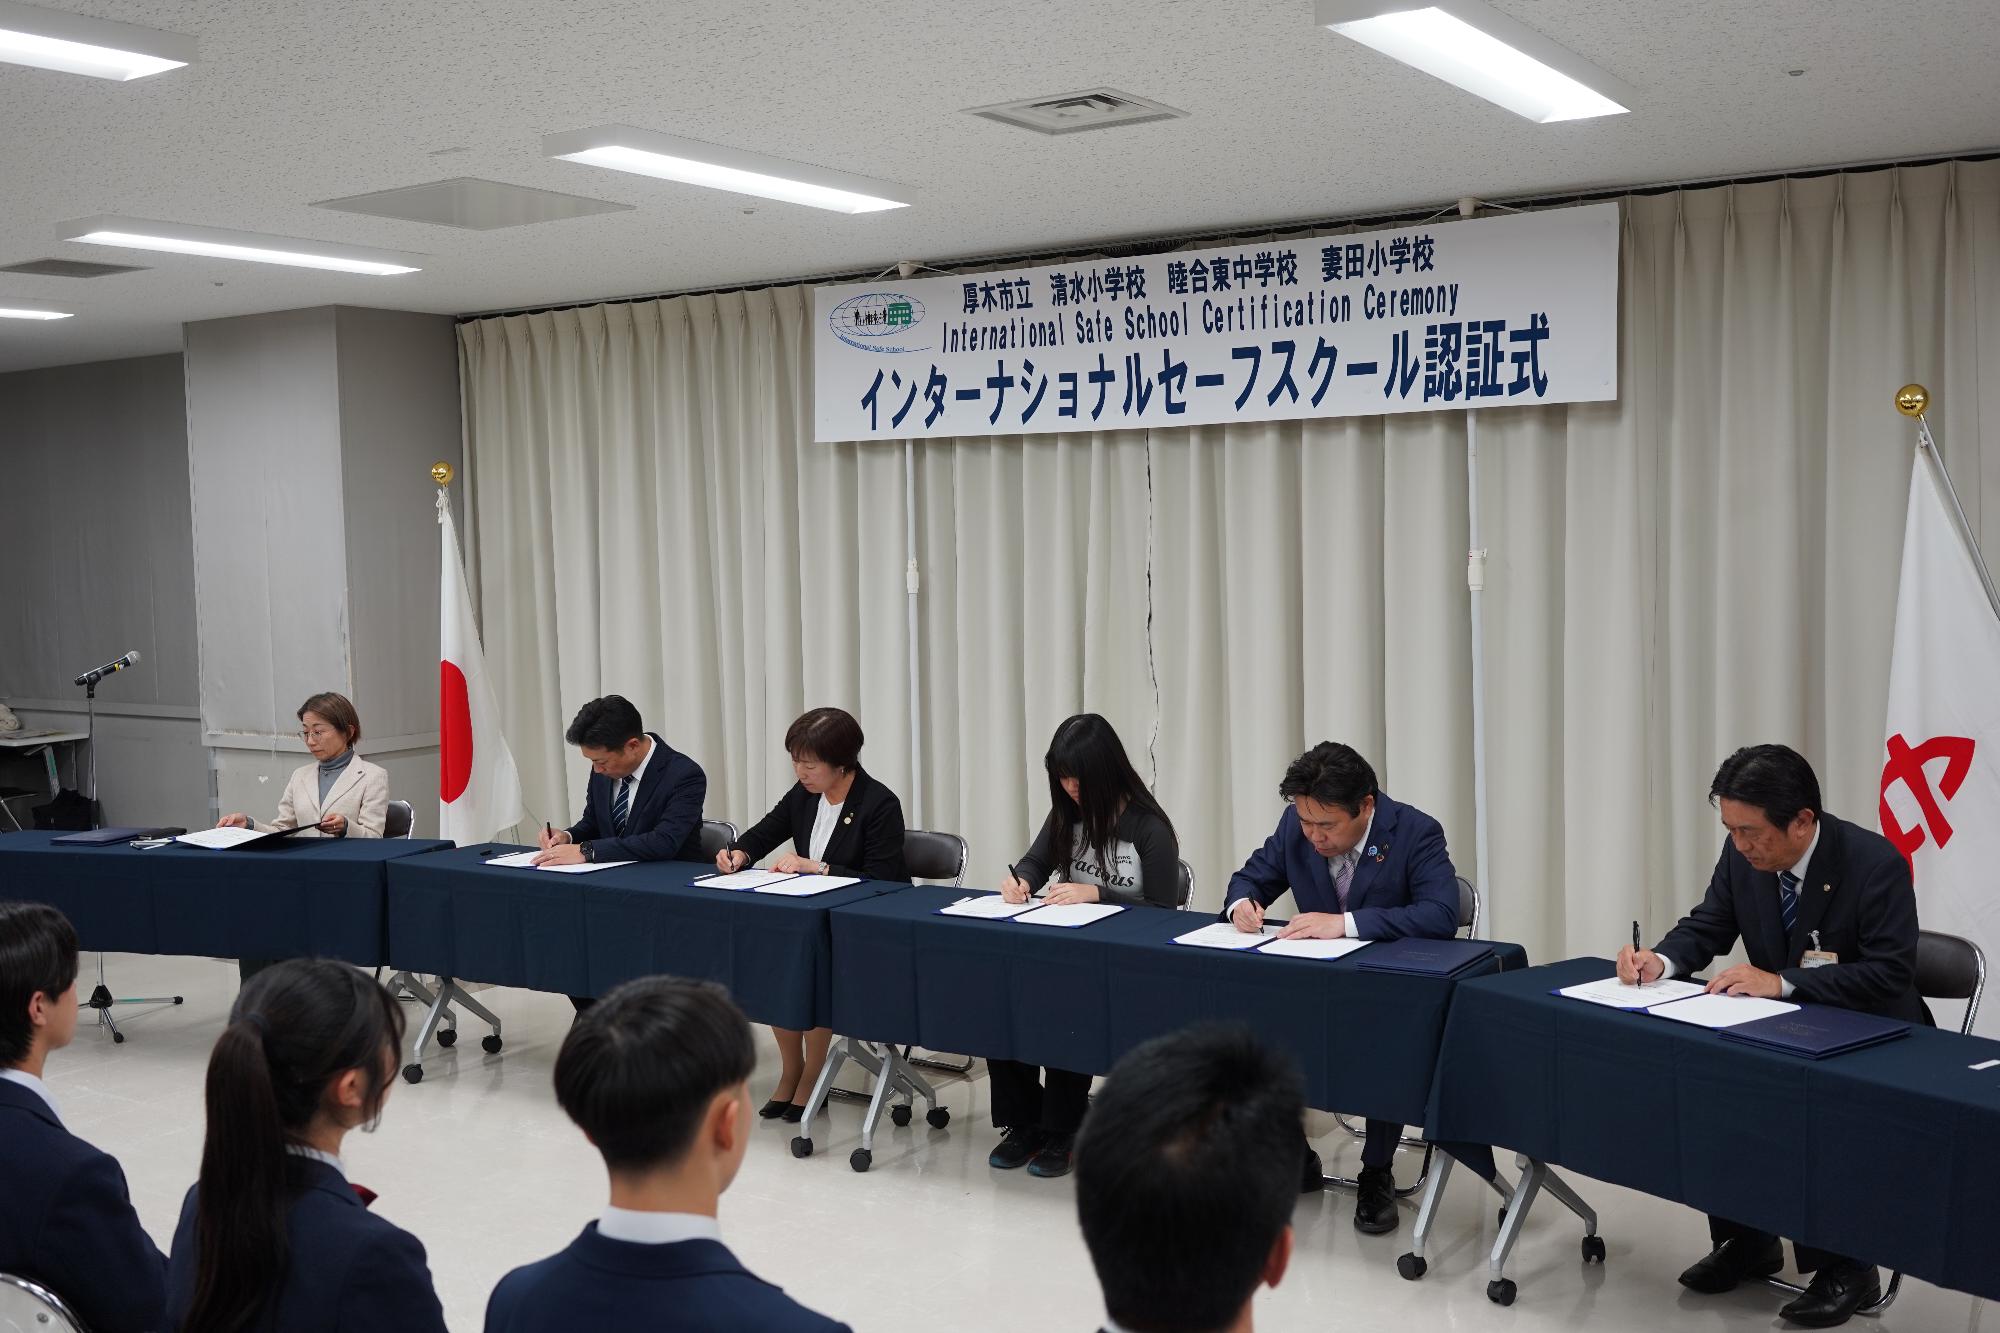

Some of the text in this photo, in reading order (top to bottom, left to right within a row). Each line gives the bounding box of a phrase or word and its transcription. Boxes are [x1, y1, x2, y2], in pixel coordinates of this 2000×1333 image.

[962, 234, 1435, 315] 厚木市立 清水小学校 睦合東中学校 妻田小学校
[942, 283, 1459, 354] International Safe School Certification Ceremony
[860, 312, 1550, 431] インターナショナルセーフスクール認証式
